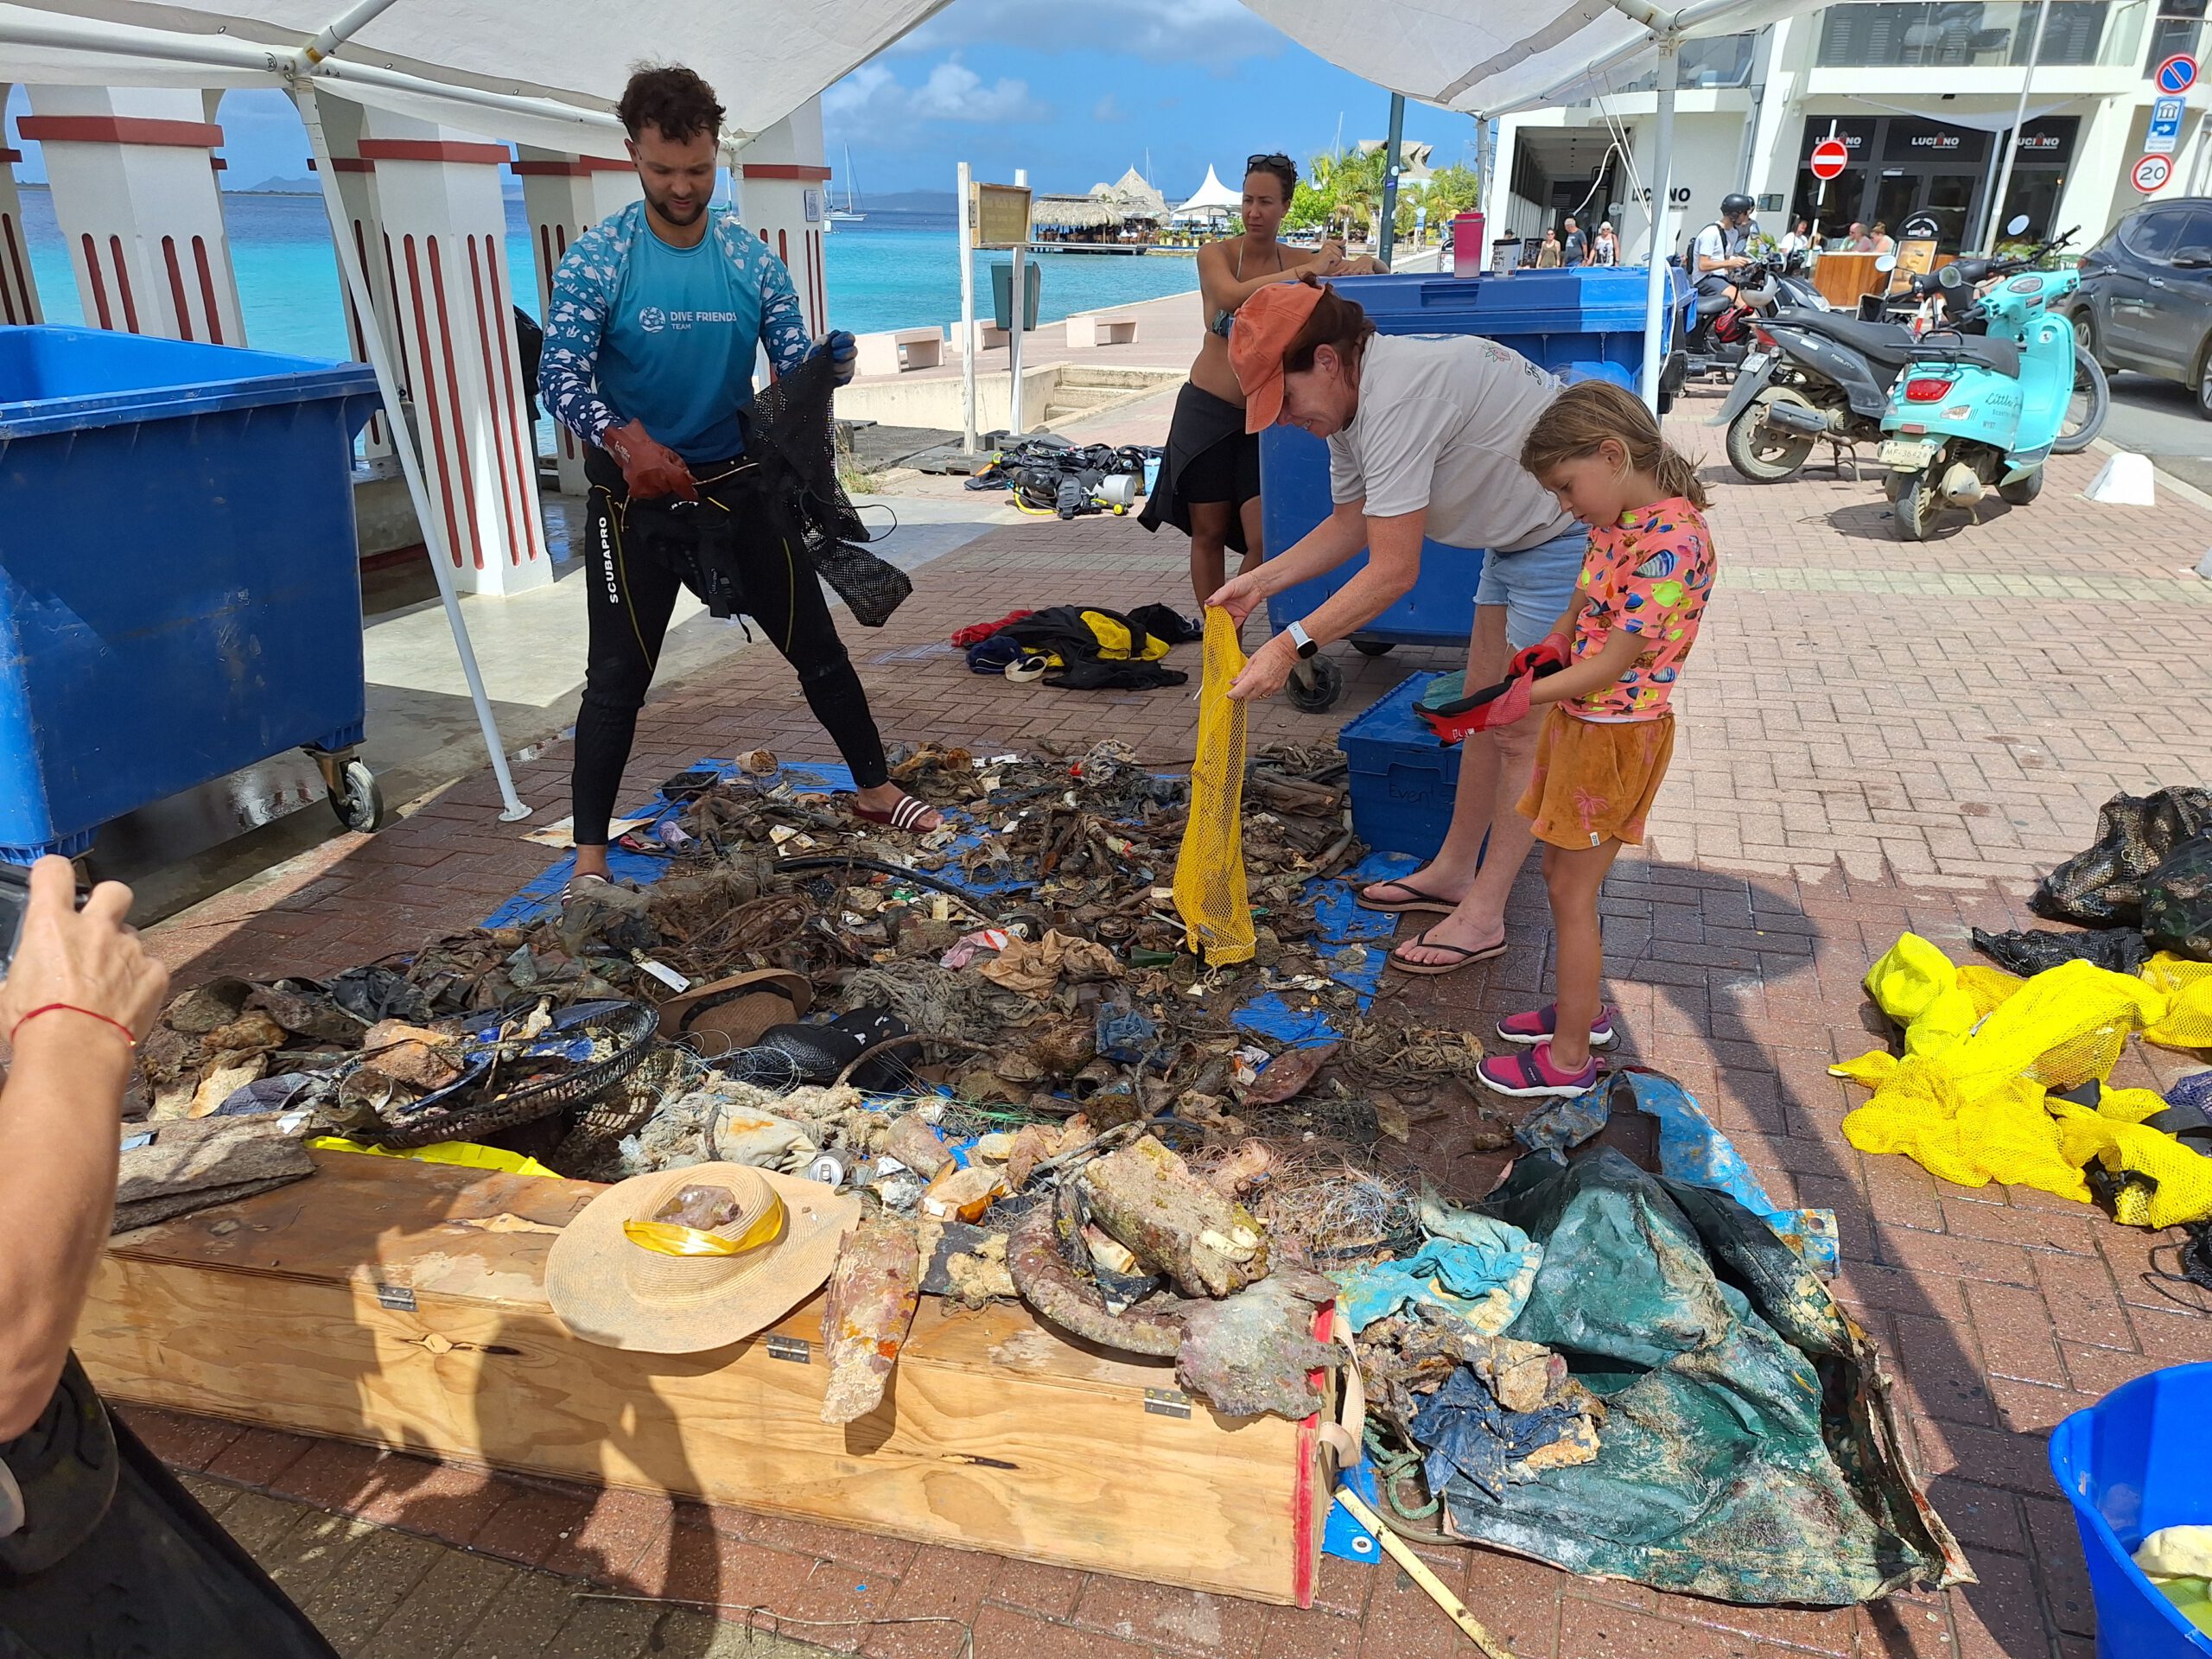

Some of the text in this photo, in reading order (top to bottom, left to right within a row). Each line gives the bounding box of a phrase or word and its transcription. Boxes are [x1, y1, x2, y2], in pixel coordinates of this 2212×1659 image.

[2018, 136, 2060, 146] UCIANO
[2139, 166, 2166, 181] 20
[1631, 188, 1691, 202] LUCNO
[670, 311, 737, 322] DIVE FRIENDS
[599, 517, 619, 604] SCUBAPRO
